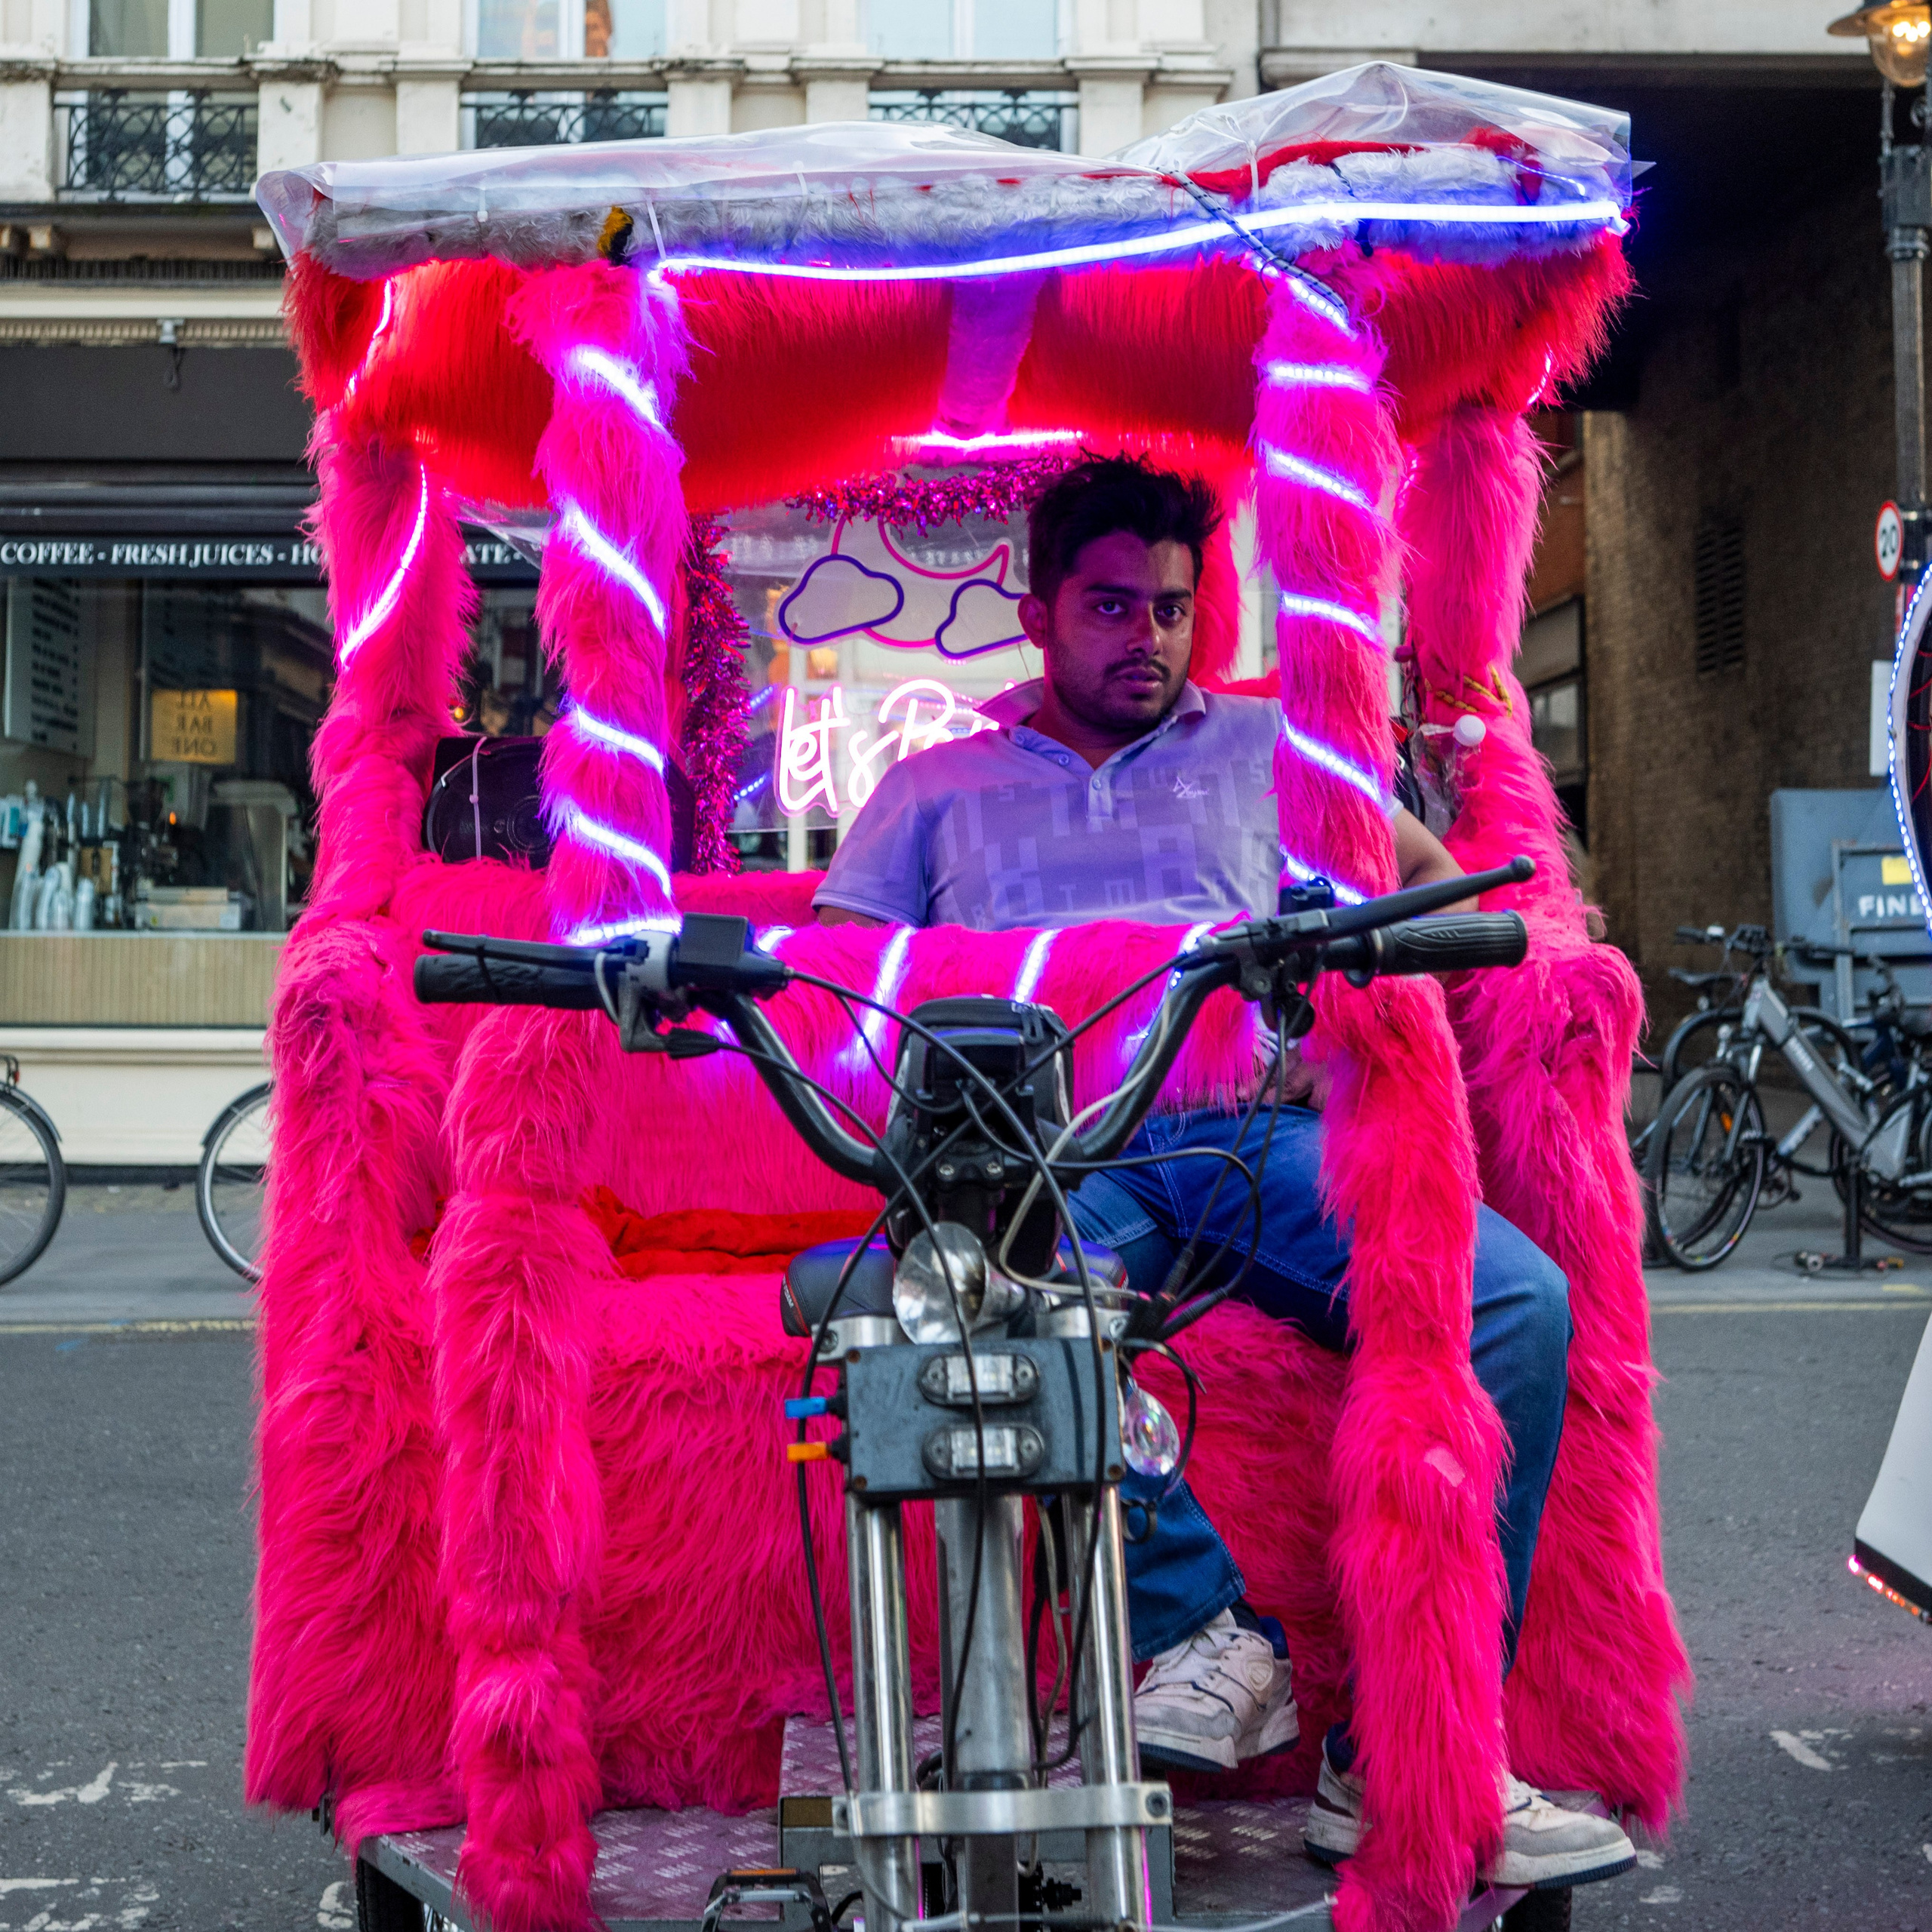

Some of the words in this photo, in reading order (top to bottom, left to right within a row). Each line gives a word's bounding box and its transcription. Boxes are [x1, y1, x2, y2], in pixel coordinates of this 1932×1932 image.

[0, 541, 94, 565] COFFEE
[111, 543, 188, 565] FRESH
[189, 543, 274, 568] JUICES
[1881, 525, 1897, 559] 20
